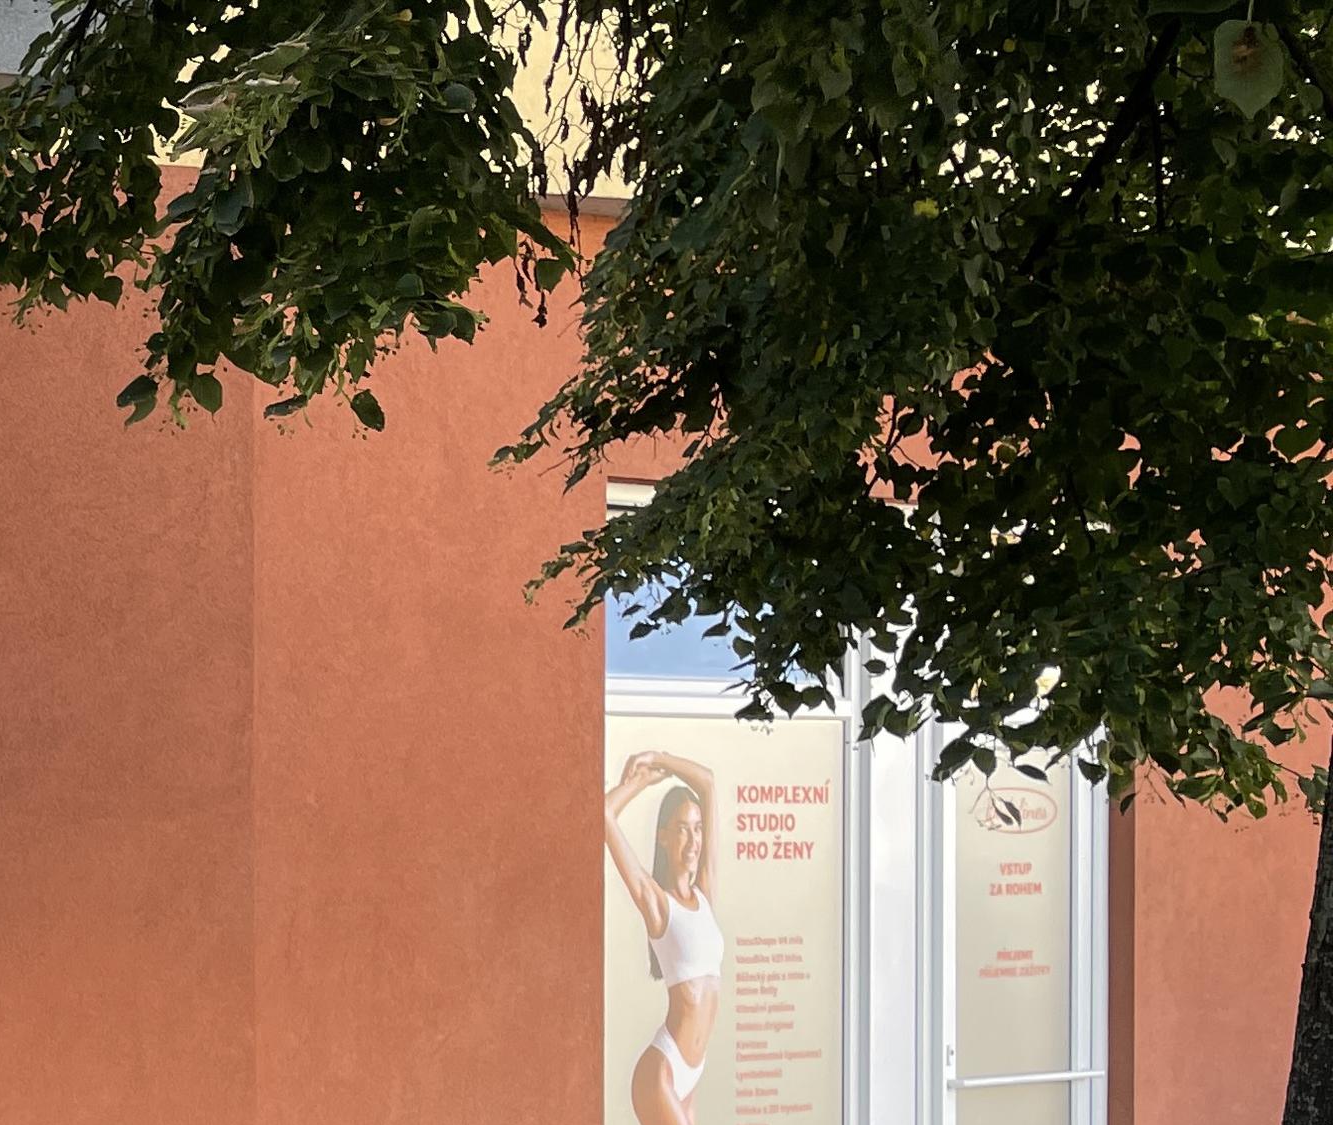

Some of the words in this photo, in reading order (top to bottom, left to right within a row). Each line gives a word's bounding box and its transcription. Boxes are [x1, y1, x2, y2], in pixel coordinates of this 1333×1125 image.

[736, 778, 831, 804] KOMPLEXNÍ
[736, 813, 796, 832] STUDIO
[736, 841, 769, 860] PRO
[772, 834, 815, 860] ŽENY
[999, 862, 1033, 876] VSTUP
[989, 883, 1003, 896] ZA
[1005, 882, 1043, 896] ROHEM
